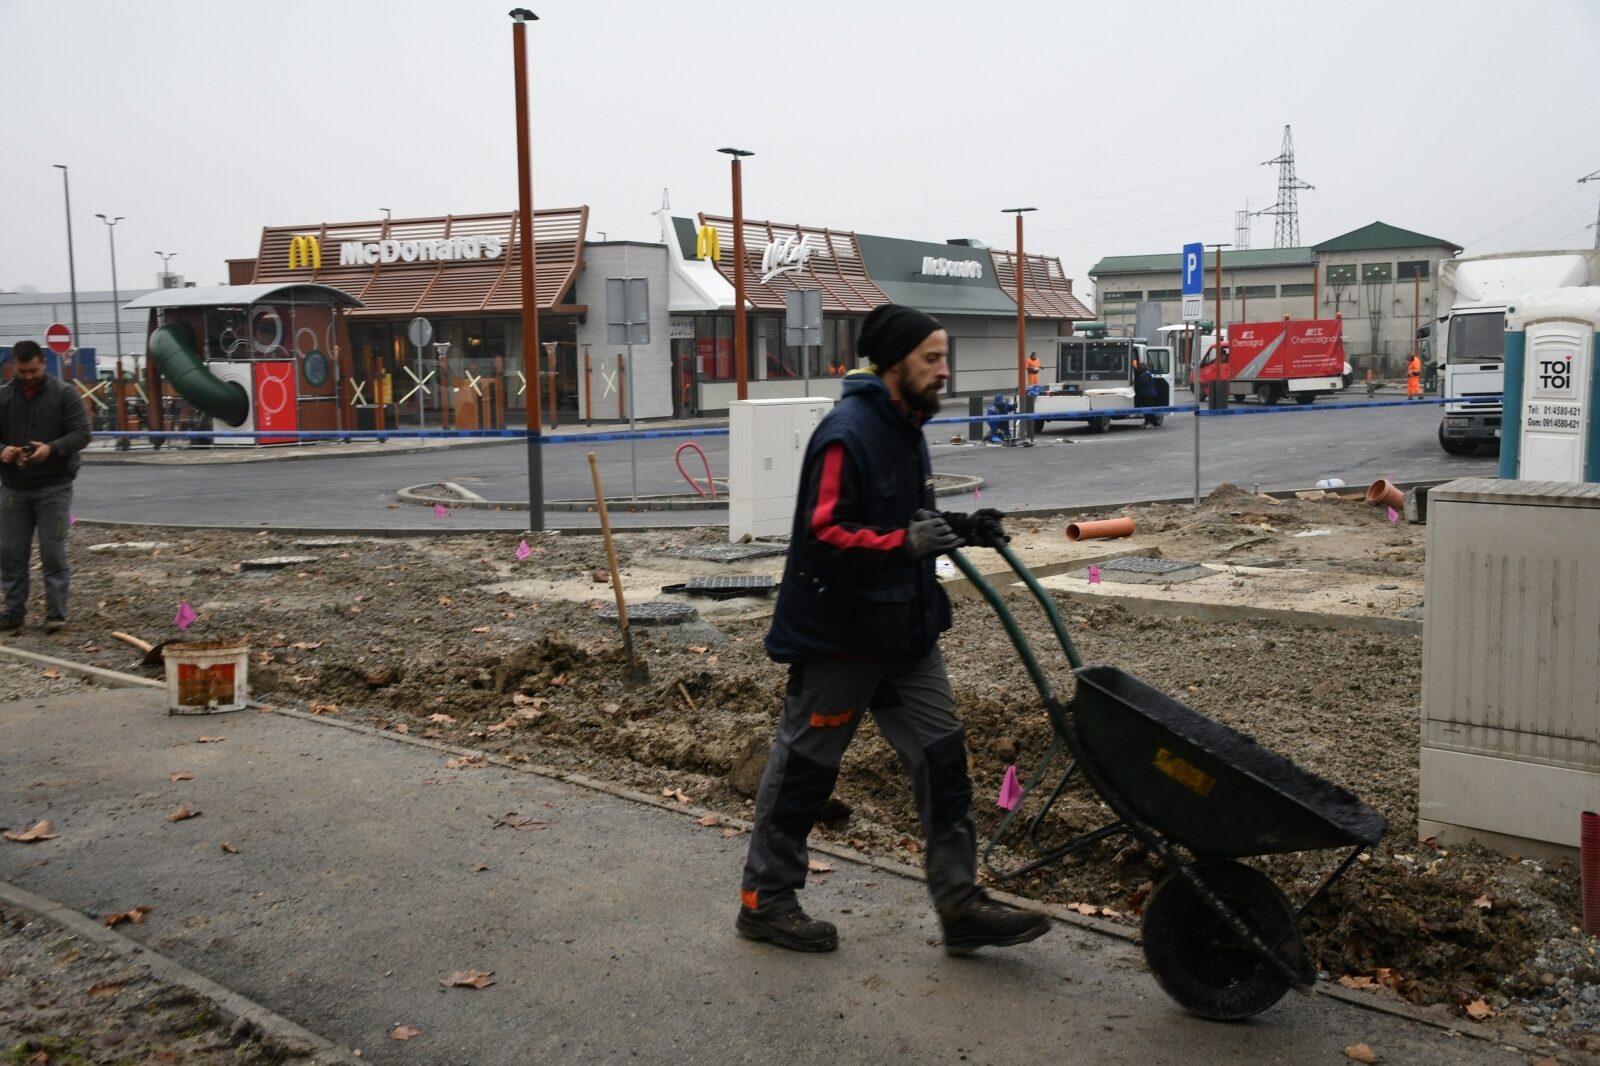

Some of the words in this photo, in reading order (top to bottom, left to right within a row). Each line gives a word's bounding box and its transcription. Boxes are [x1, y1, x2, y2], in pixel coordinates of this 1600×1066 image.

[340, 235, 502, 265] McDonald's
[922, 256, 983, 279] McDonald's
[1187, 253, 1197, 285] P
[1540, 357, 1571, 374] TOI
[1540, 375, 1570, 388] TOI
[1528, 405, 1539, 414] Tel:
